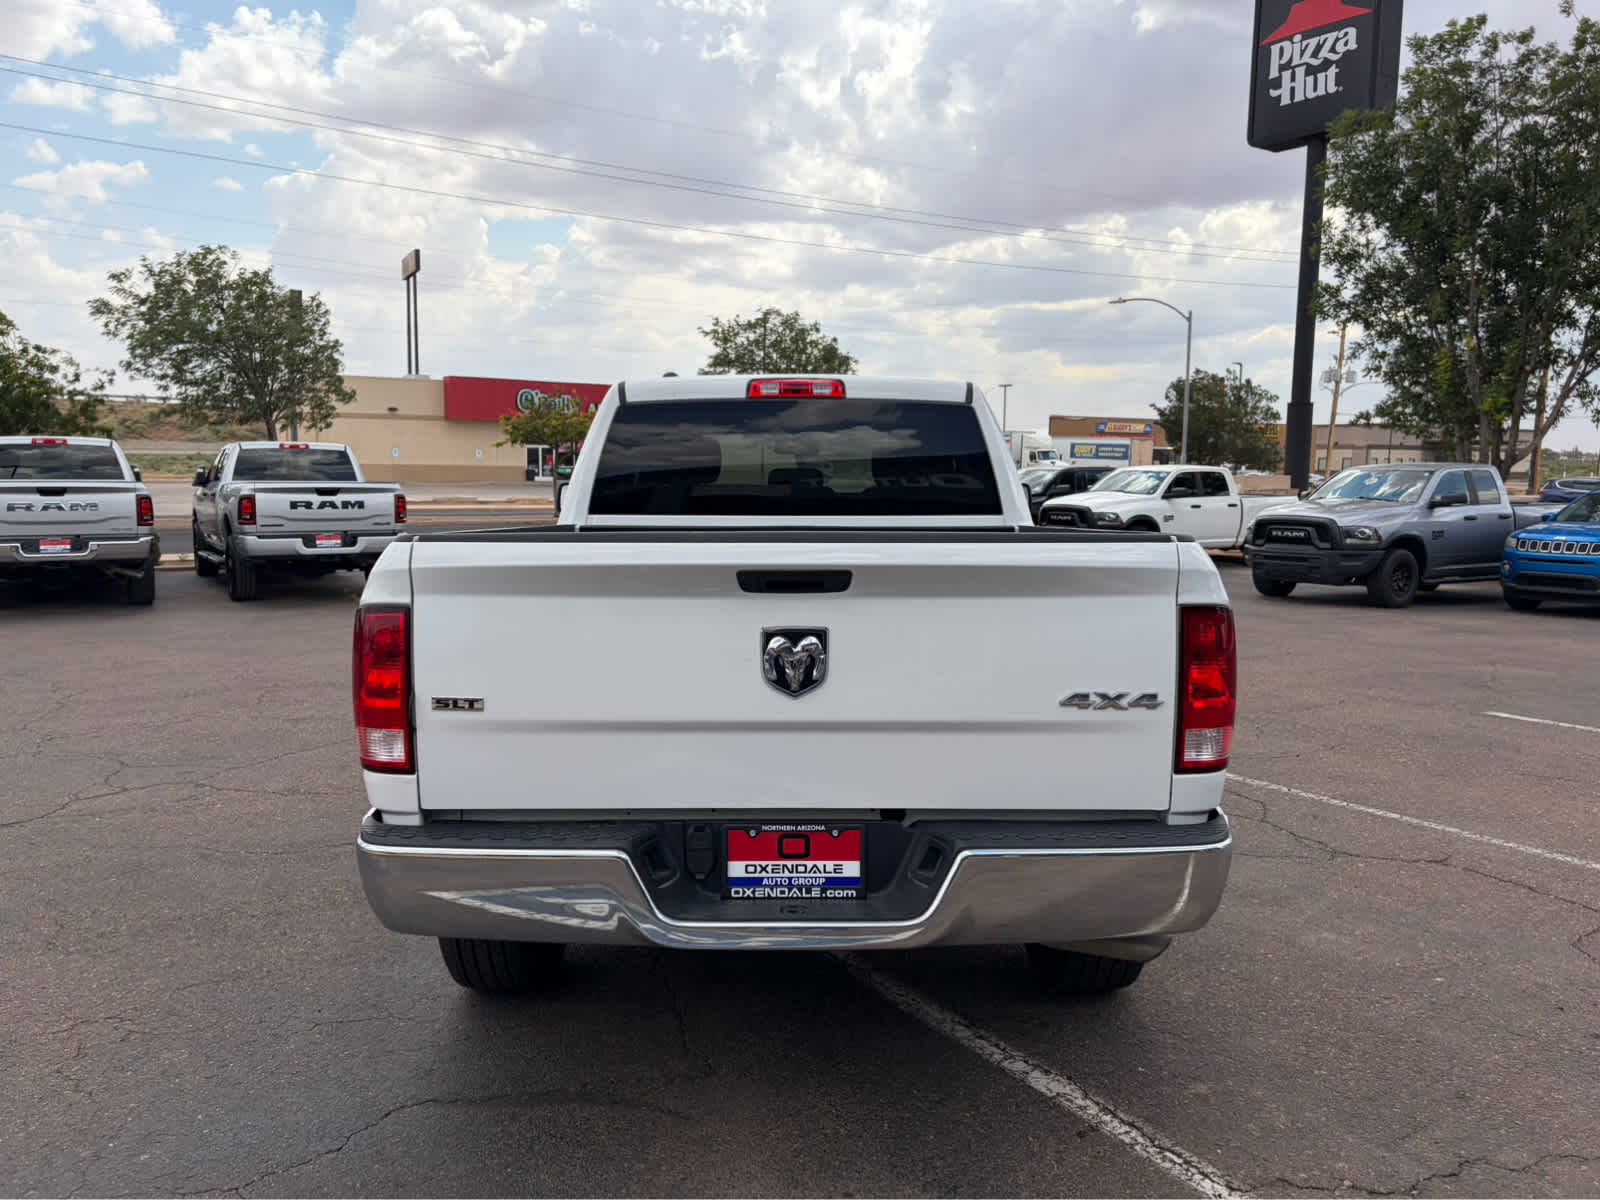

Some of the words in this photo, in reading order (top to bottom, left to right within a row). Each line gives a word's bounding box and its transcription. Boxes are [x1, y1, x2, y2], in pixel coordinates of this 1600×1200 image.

[1268, 26, 1359, 80] Pizza
[1269, 63, 1341, 107] Hut
[289, 500, 366, 510] RAM
[433, 697, 483, 711] SLT
[761, 824, 796, 832] NORTHERN
[796, 824, 826, 832] ARIZONA
[744, 863, 844, 875] OXENDALE
[761, 877, 790, 886] AUTO
[791, 877, 826, 886] GROUP
[730, 887, 857, 898] OXENDALE.com
